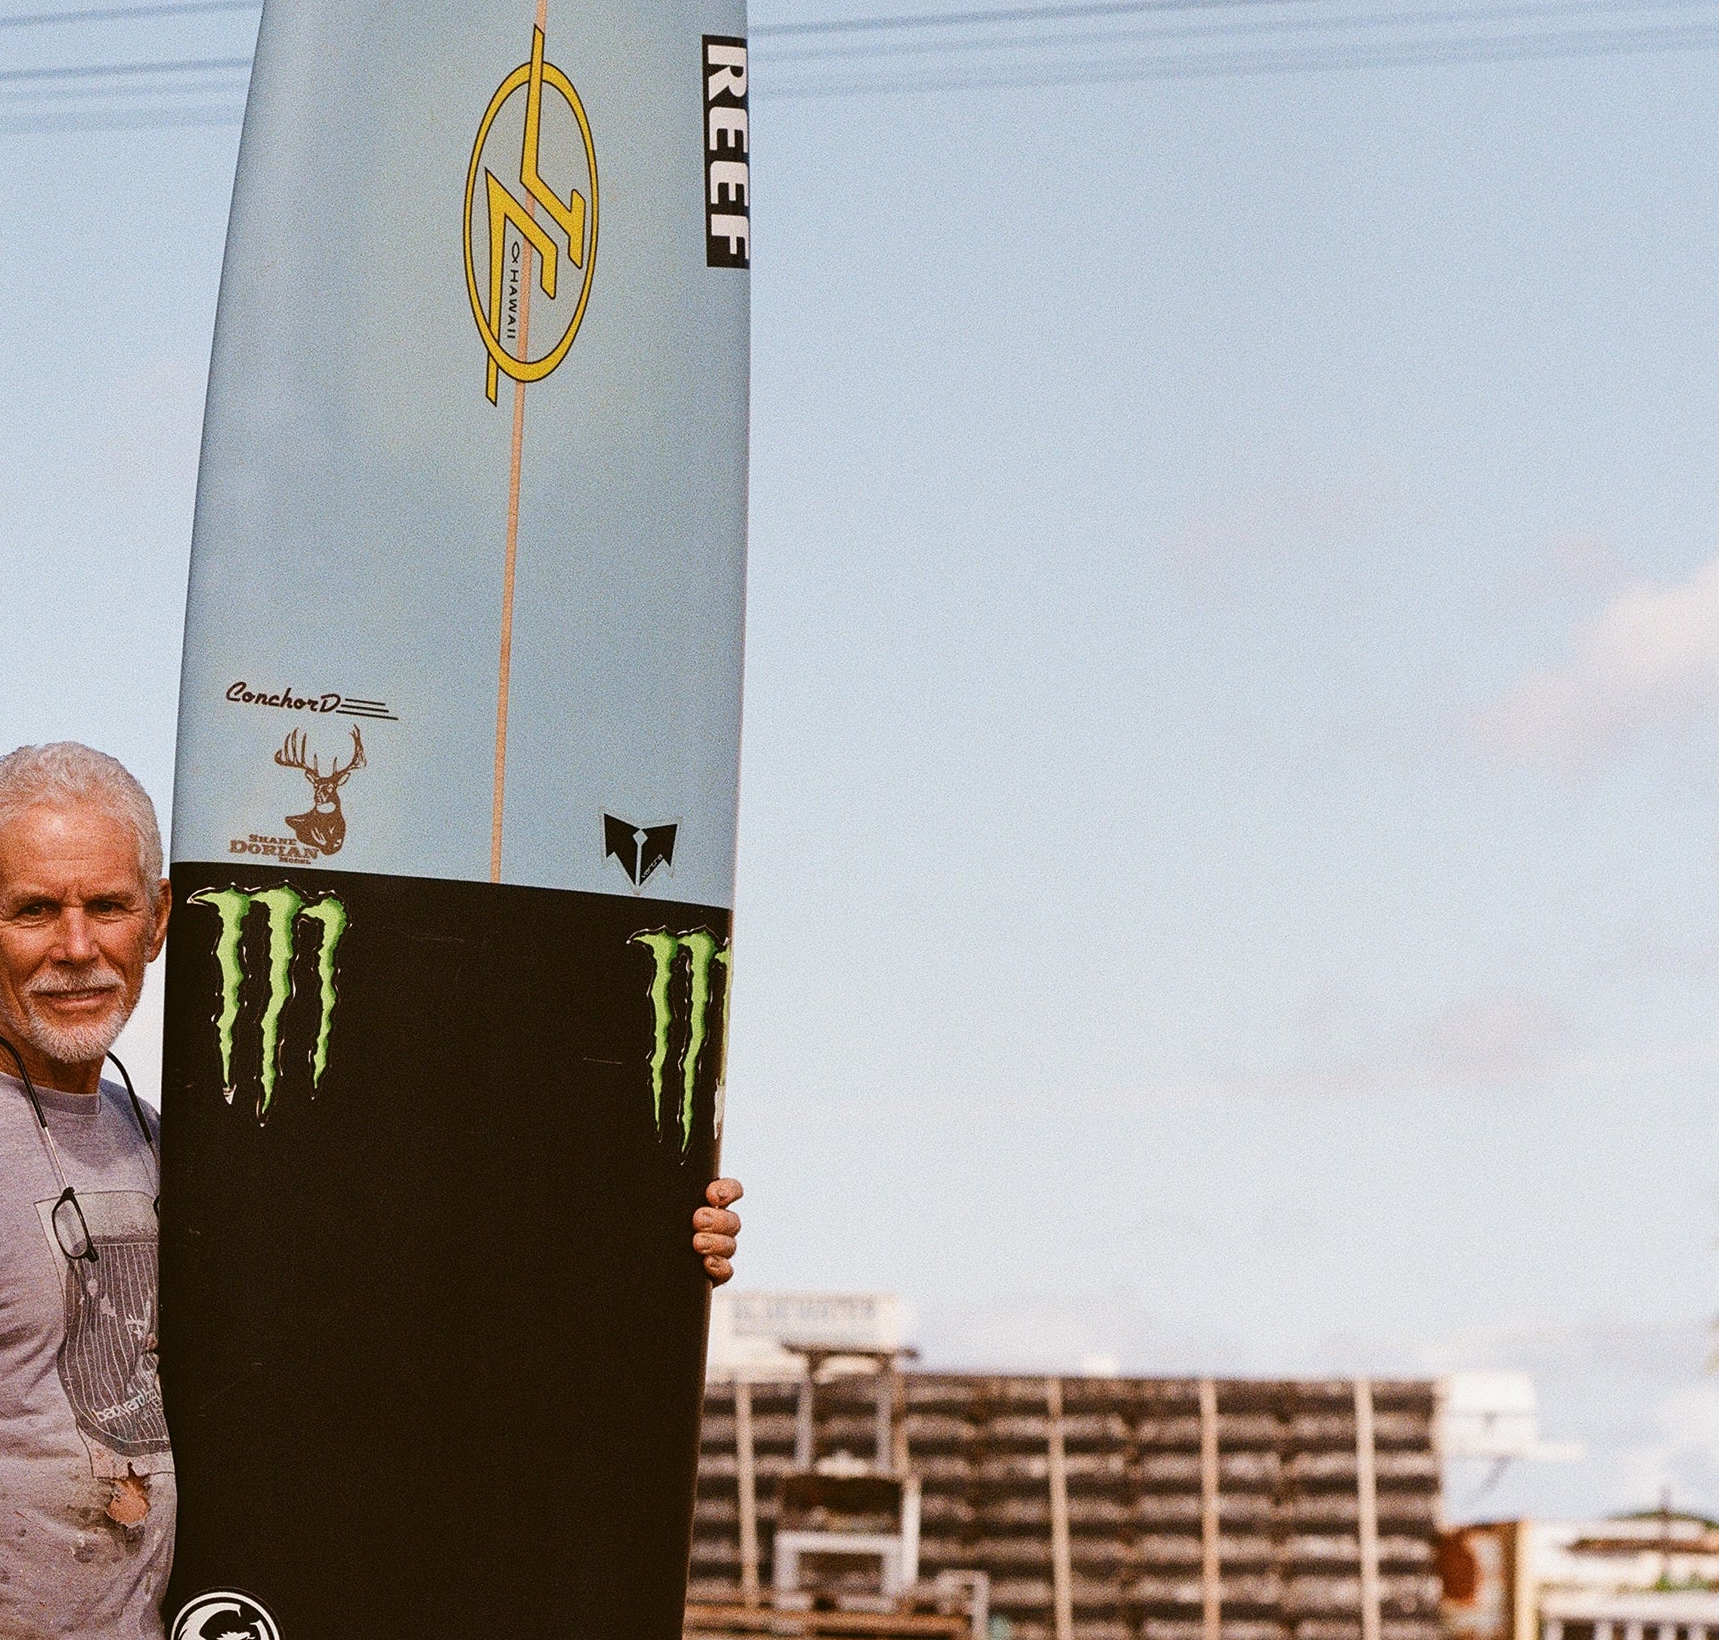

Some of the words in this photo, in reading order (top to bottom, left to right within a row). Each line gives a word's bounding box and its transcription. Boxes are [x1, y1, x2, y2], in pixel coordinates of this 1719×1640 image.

[707, 44, 750, 261] REEF
[506, 270, 520, 339] HAWAII
[229, 839, 320, 860] DORIAN
